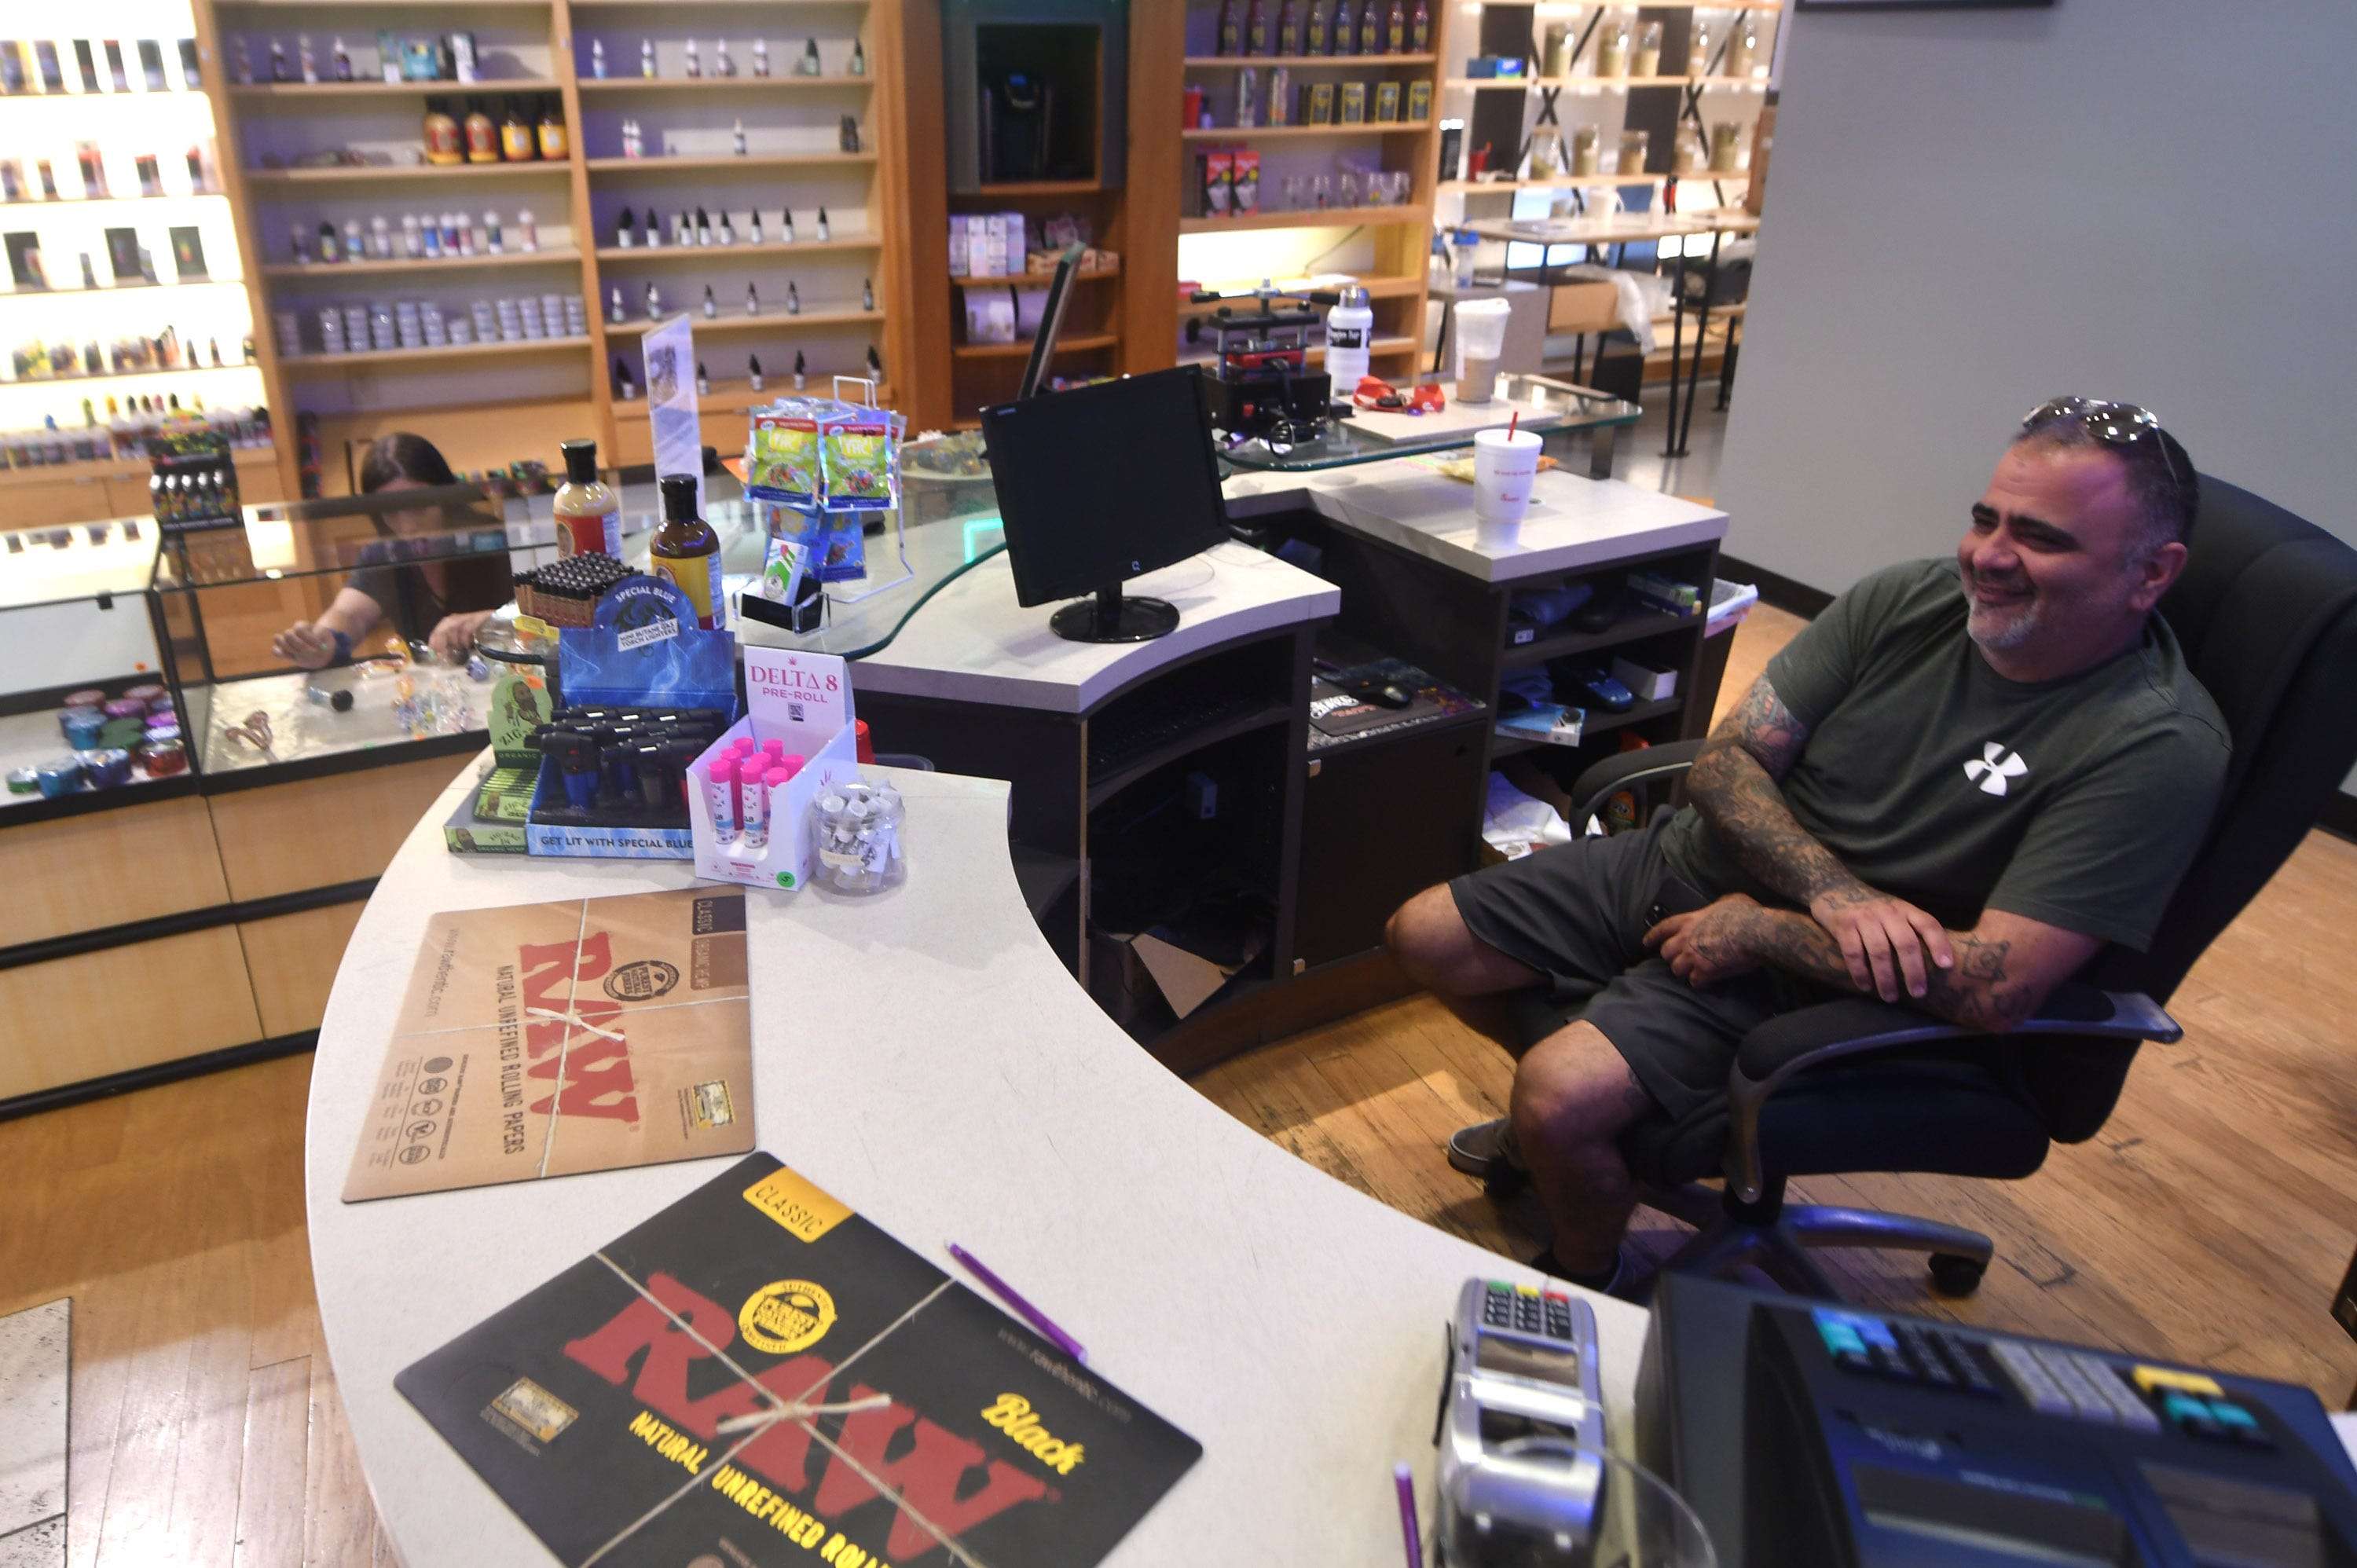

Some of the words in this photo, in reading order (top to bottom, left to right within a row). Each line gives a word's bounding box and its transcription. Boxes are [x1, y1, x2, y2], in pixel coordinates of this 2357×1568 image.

[614, 586, 651, 603] SPECIAL
[652, 587, 676, 603] BLUE
[762, 687, 828, 703] PRE-ROLL
[826, 674, 838, 692] 8
[541, 836, 561, 846] GET
[566, 837, 582, 846] LIT
[585, 837, 614, 847] WITH
[618, 838, 663, 848] SPECIAL
[666, 839, 694, 849] BLUE
[696, 900, 713, 932] CLASSIC
[496, 965, 517, 1004] NATURAL
[497, 1005, 520, 1061] UNREFINED
[519, 931, 640, 1123] RAW
[500, 1063, 523, 1108] ROLLING
[503, 1111, 525, 1156] PAPERS
[755, 1185, 823, 1233] CLASSIC
[560, 1270, 1048, 1563] RAW
[981, 1392, 1085, 1476] Black
[629, 1410, 708, 1475] NATURAL
[711, 1464, 826, 1550] UNREFINED
